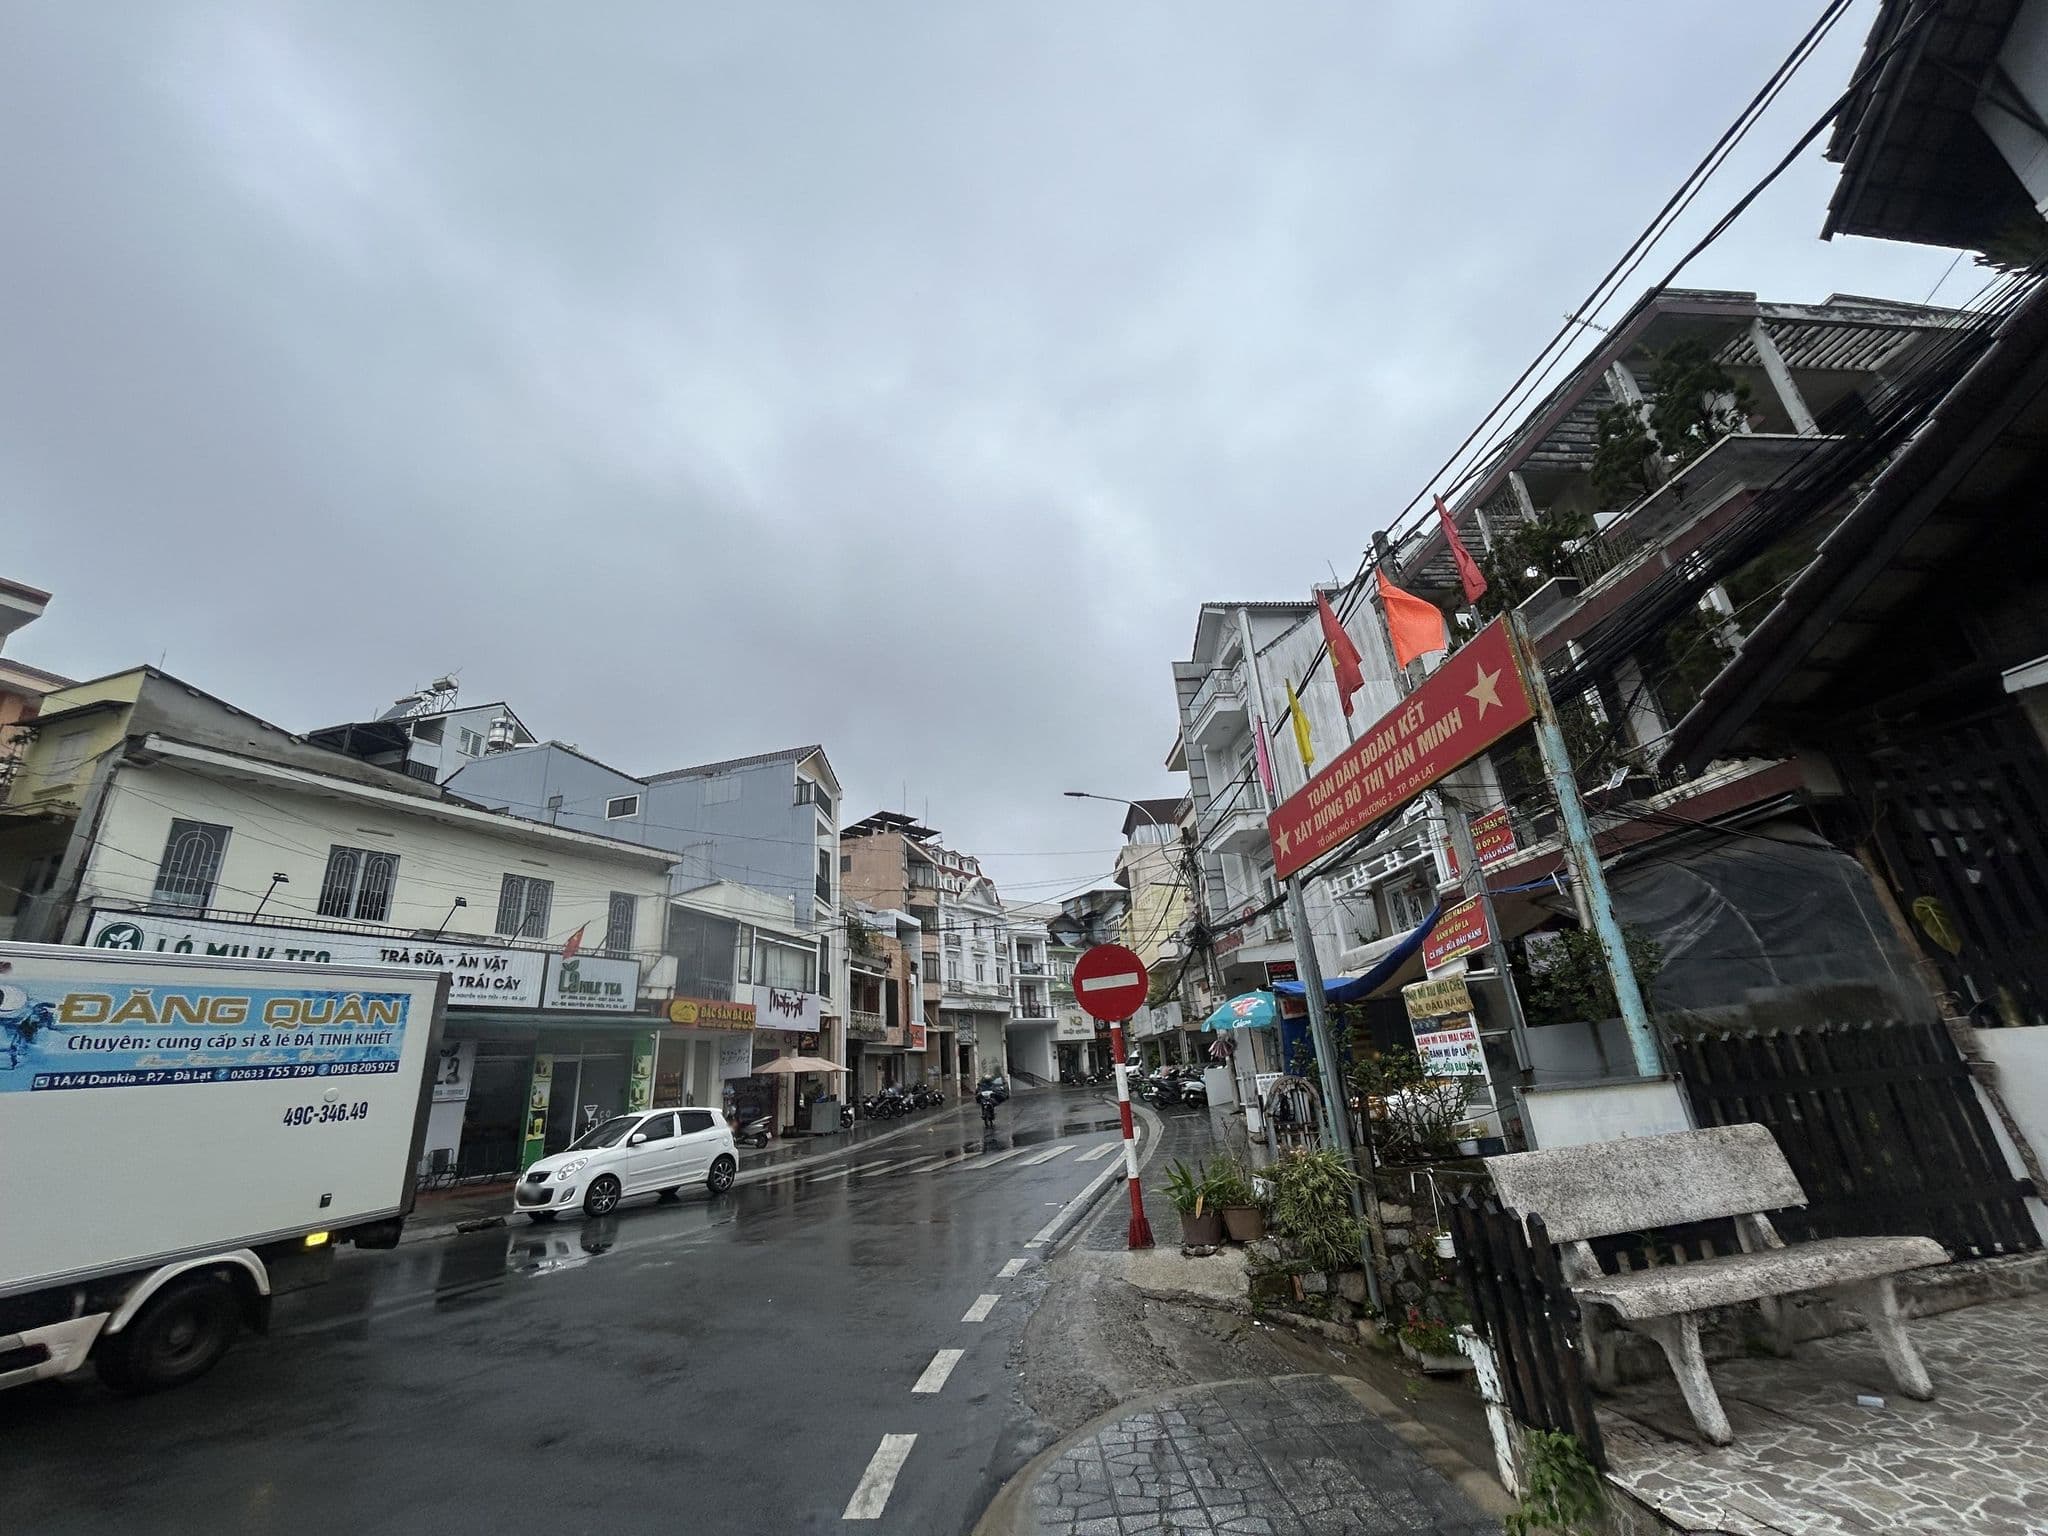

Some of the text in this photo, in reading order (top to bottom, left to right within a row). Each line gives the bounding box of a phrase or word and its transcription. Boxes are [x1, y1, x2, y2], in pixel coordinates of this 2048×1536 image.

[1307, 700, 1425, 810] TOÀN DÂN ĐOÀN KẾT
[1294, 707, 1463, 845] XÂY DỰNG ĐÔ THỊ VĂN MINH
[380, 948, 410, 963] TRÀ
[414, 950, 444, 966] SỮA
[456, 953, 479, 969] ĂN
[484, 956, 508, 972] VẶT
[458, 973, 490, 988] TRÁI
[493, 977, 521, 991] CÂY
[604, 982, 622, 995] TEA
[57, 988, 401, 1030] ĐĂNG QUÂN
[68, 1035, 151, 1053] Chuyên:
[156, 1037, 201, 1051] cung
[207, 1034, 236, 1050] cấp
[259, 1034, 271, 1047] &
[294, 1031, 314, 1046] ĐÁ
[355, 1029, 392, 1045] KHIẾT
[53, 1074, 85, 1086] 1A/4
[89, 1072, 136, 1085] Dankia
[147, 1073, 163, 1081] P.7
[174, 1070, 190, 1081] Đà
[193, 1070, 212, 1083] Lạt
[231, 1068, 264, 1079] 02633
[267, 1065, 291, 1077] 755
[294, 1064, 315, 1076] 799
[283, 1101, 368, 1127] 49C-346.49
